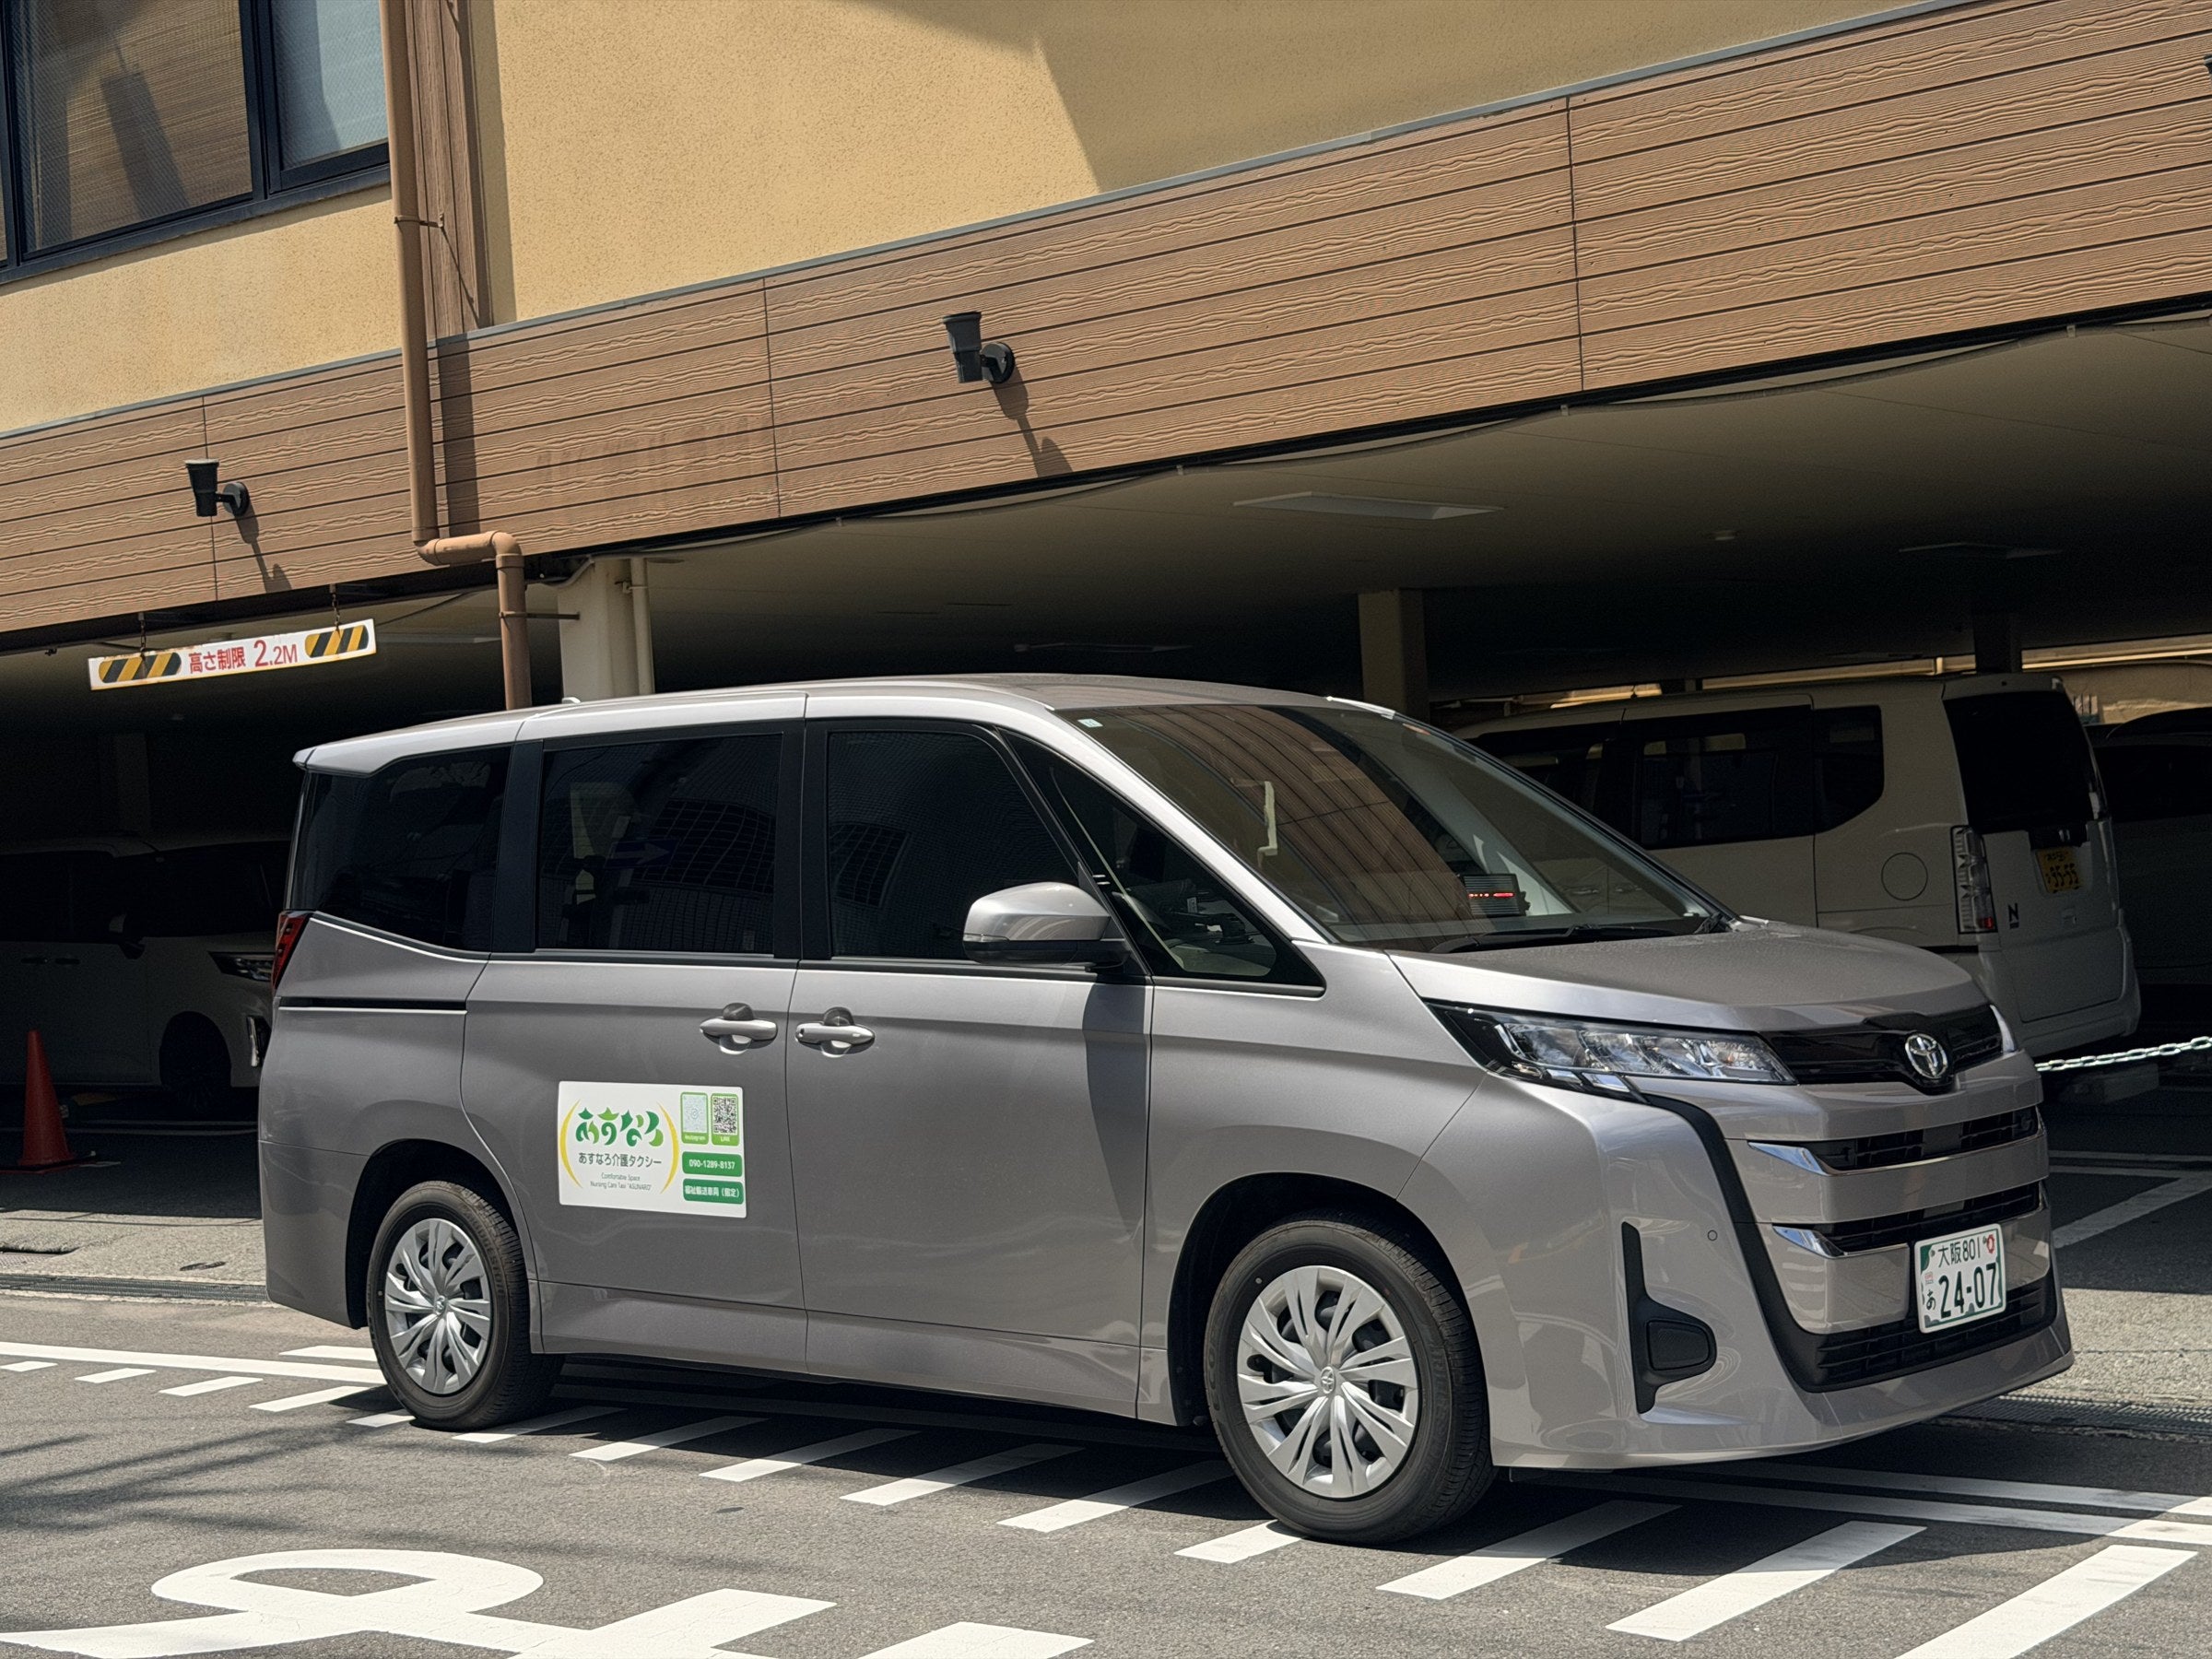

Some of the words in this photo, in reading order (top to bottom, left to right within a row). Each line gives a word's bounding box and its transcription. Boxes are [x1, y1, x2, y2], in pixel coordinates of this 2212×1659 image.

[189, 646, 245, 674] 高さ制限
[253, 639, 298, 667] 2.2M
[575, 1107, 664, 1147] あすなろ
[578, 1151, 662, 1168] あすなろ介護タクシー
[688, 1159, 735, 1170] 090-1289-8137
[1925, 1288, 1936, 1311] あ
[1938, 1262, 1996, 1319] 24-07
